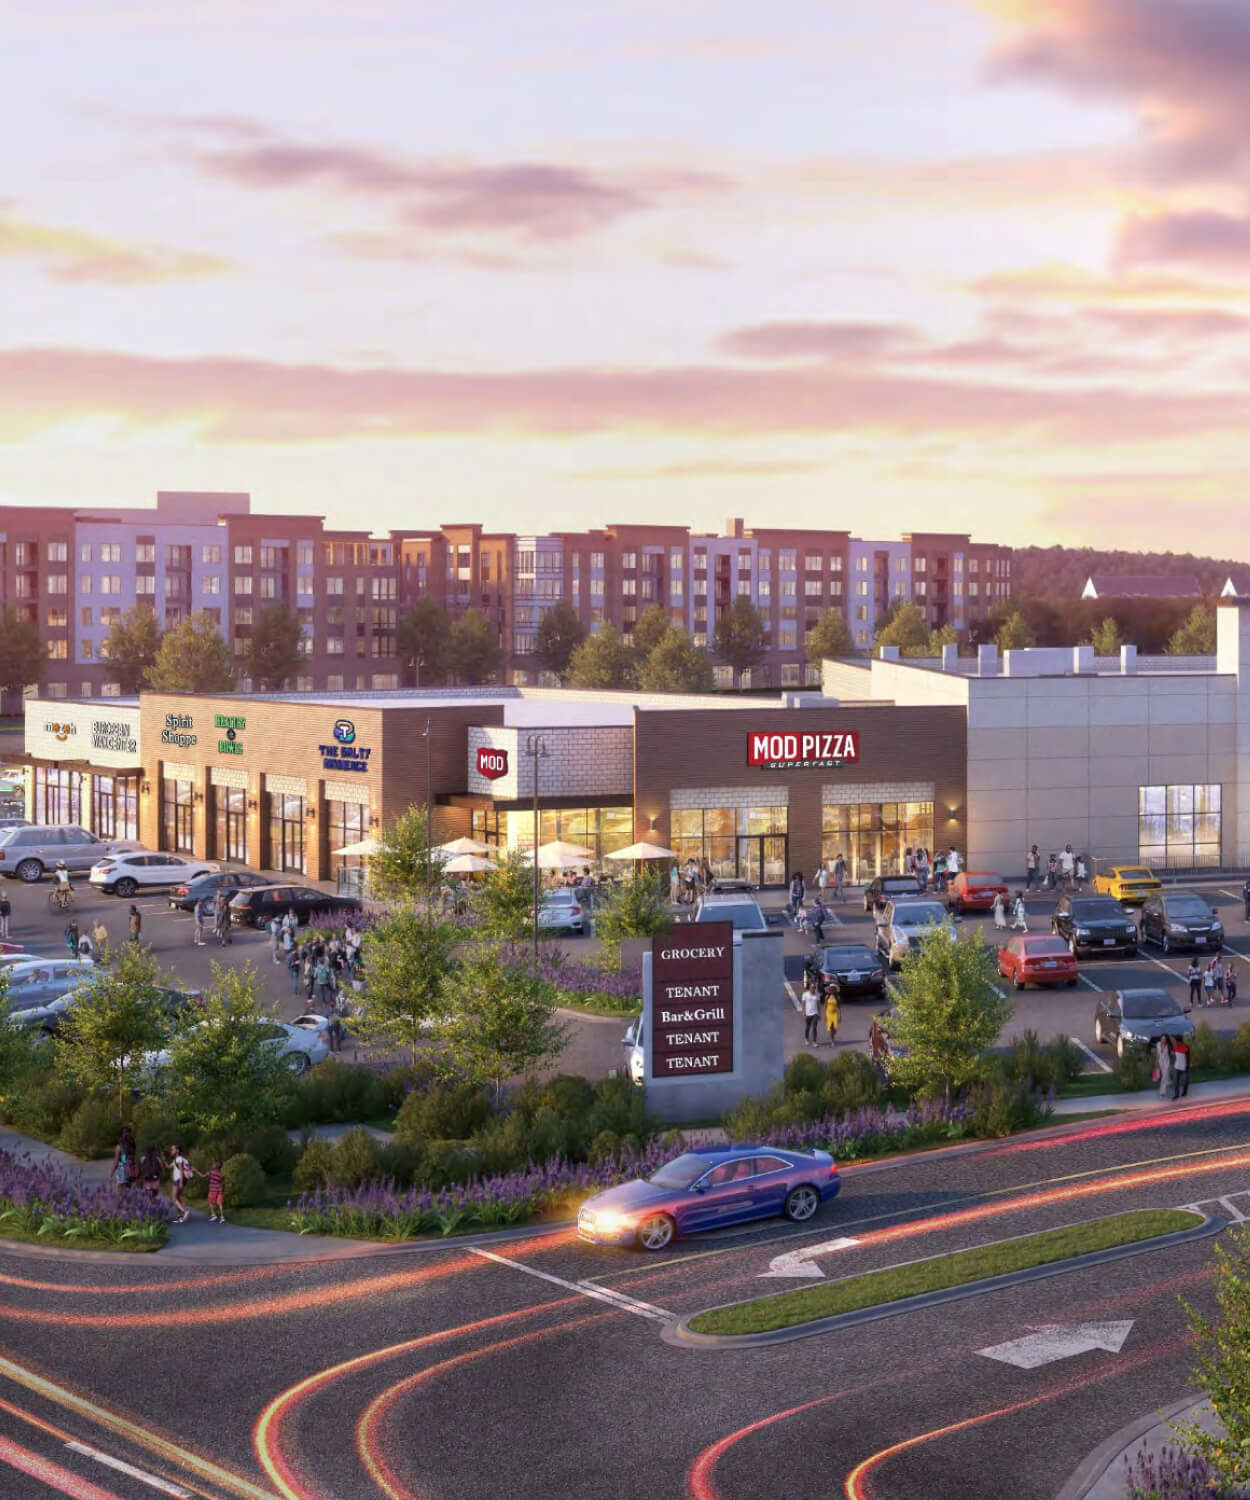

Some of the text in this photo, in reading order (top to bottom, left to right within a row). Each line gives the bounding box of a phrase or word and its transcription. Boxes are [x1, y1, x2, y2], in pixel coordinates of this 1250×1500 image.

[166, 714, 193, 730] Spirit
[162, 731, 197, 747] Shoppe
[319, 744, 338, 757] THE
[754, 734, 856, 759] MOD PIZZA
[480, 754, 504, 771] MOD
[661, 947, 725, 960] GROCERY
[665, 985, 720, 999] TENANT
[661, 1008, 725, 1023] Bar&Grill
[666, 1032, 720, 1045] TENANT
[666, 1055, 720, 1069] TENANT
